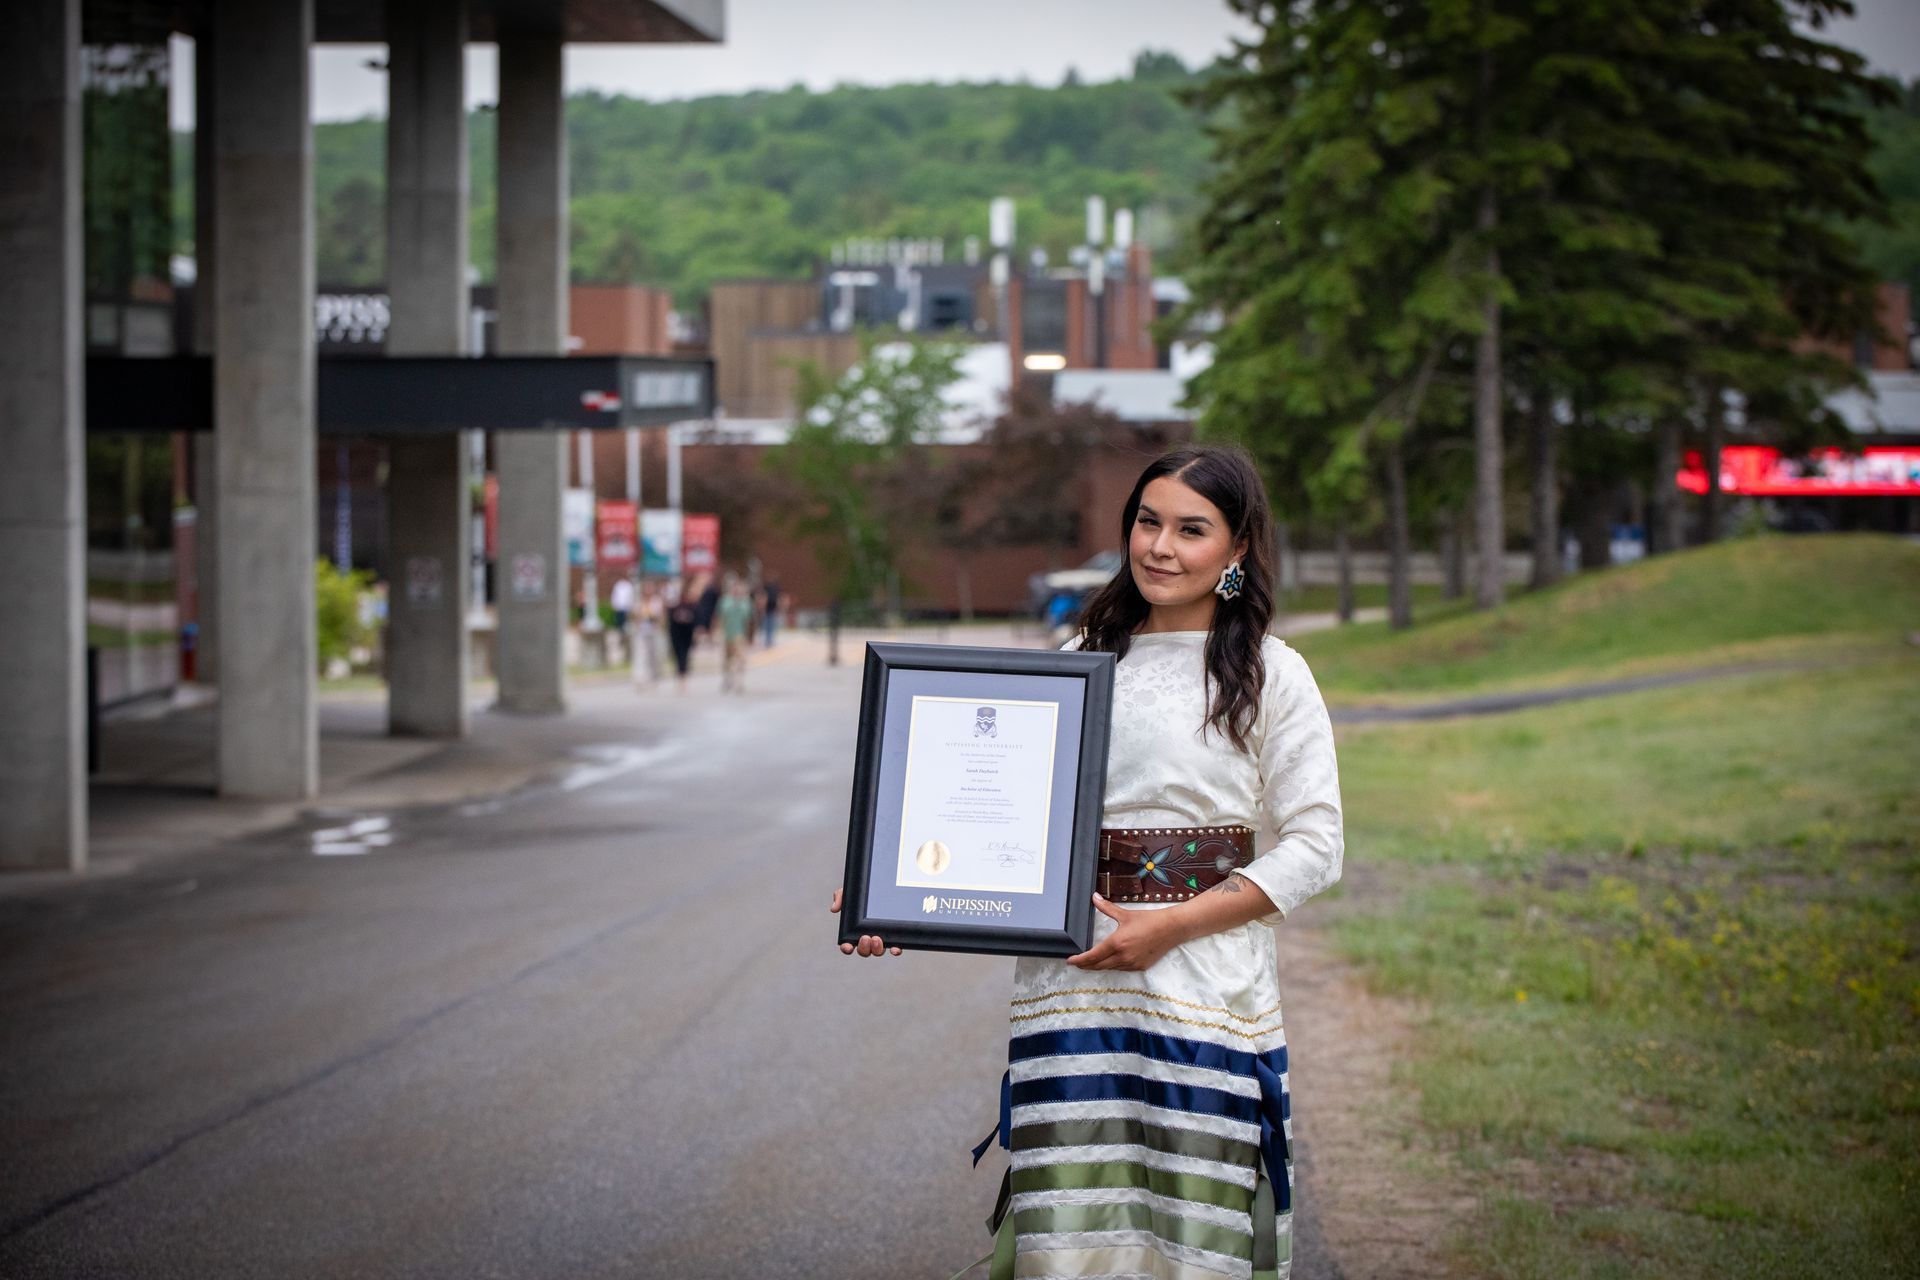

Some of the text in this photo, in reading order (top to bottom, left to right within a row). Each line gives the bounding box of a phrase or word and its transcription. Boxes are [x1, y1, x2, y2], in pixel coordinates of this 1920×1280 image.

[316, 294, 391, 330] PISS
[940, 898, 1012, 913] NIPISSING
[939, 910, 1011, 918] UNIVERSITY
